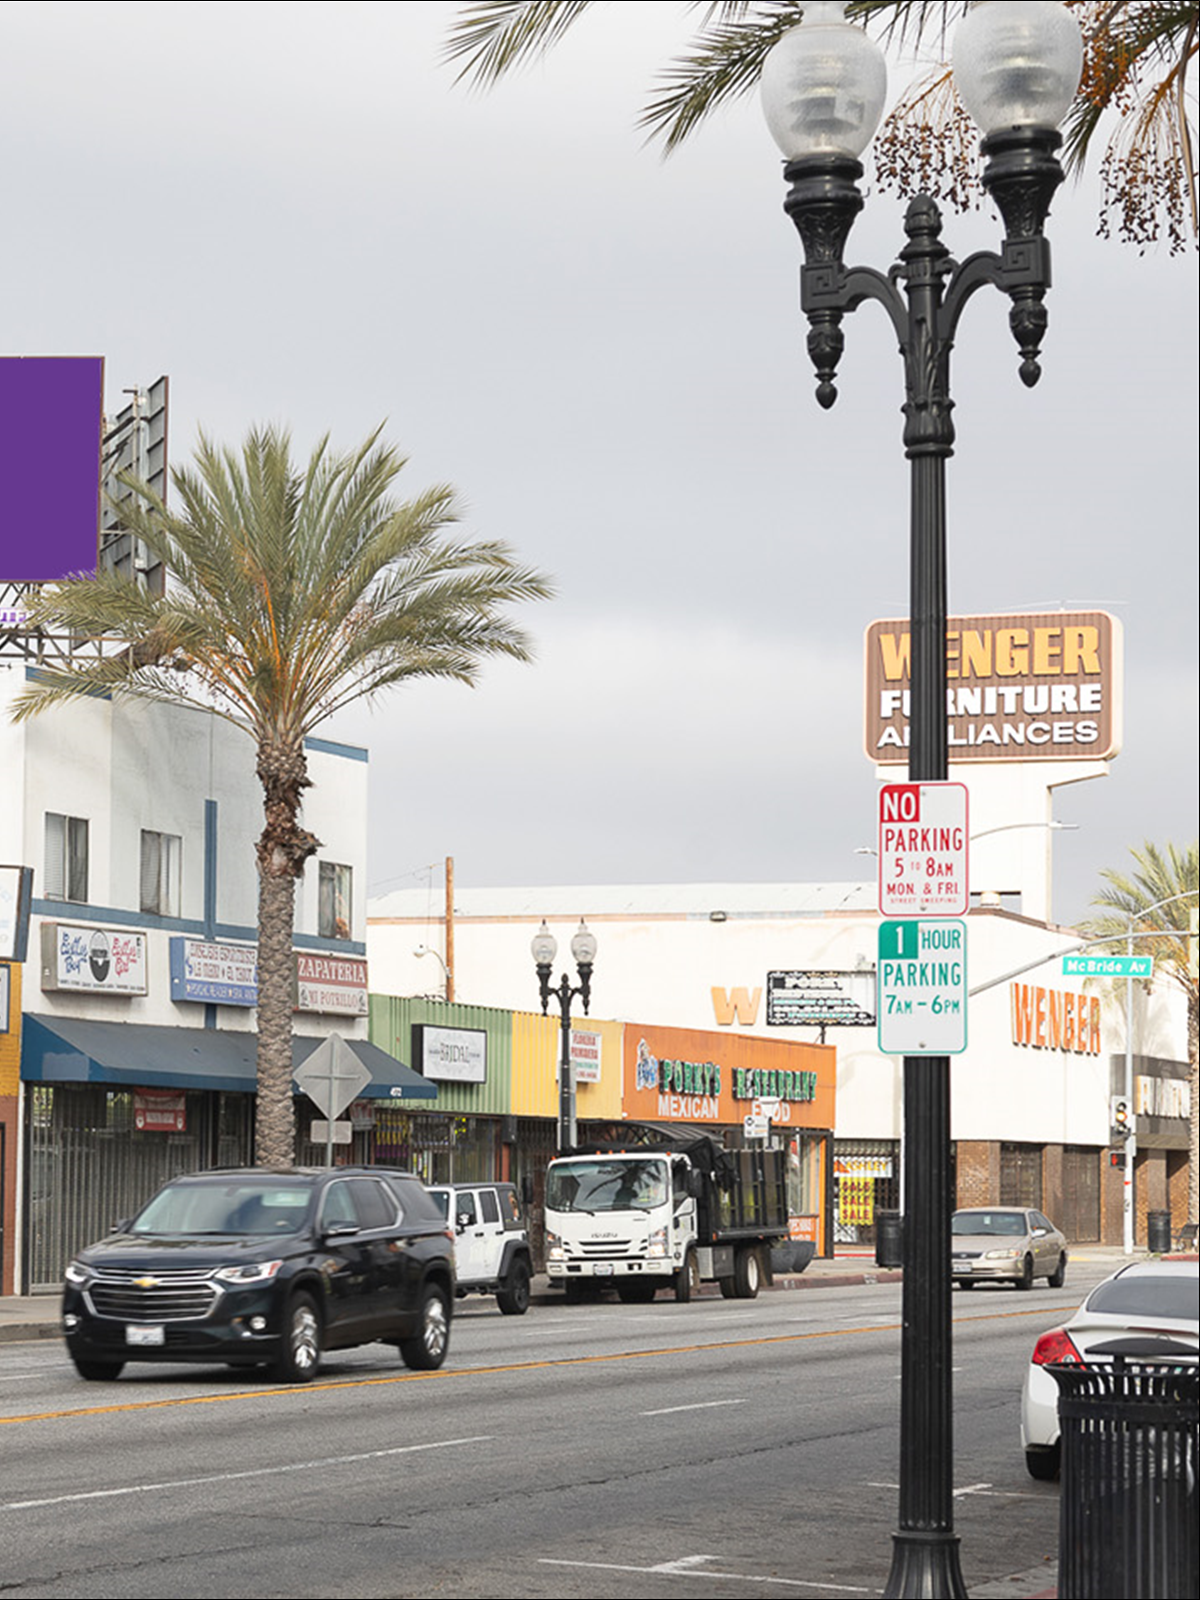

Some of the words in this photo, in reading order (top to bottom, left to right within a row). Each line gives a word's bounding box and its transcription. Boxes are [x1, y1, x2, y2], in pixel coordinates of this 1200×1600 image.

[877, 720, 1099, 747] ALIANCES
[883, 792, 916, 820] NO
[885, 827, 963, 852] PARKING
[894, 857, 905, 878] 5
[926, 857, 954, 878] 8AM
[923, 882, 932, 895] &
[895, 925, 904, 955] 1
[922, 928, 962, 950] HOUR
[298, 957, 366, 983] ZAPATERIA
[884, 962, 962, 986] PARKING
[1067, 959, 1123, 973] McBride
[1129, 961, 1147, 973] Av
[885, 994, 913, 1014] 7AM
[931, 994, 961, 1015] 6PM
[1010, 982, 1101, 1054] WENGER
[658, 1095, 719, 1119] MEXICAN
[752, 1100, 791, 1122] FOD
[845, 1160, 888, 1172] ASHLEY
[842, 1180, 870, 1192] SALE
[842, 1195, 870, 1206] SALE
[842, 1208, 870, 1220] SALE
